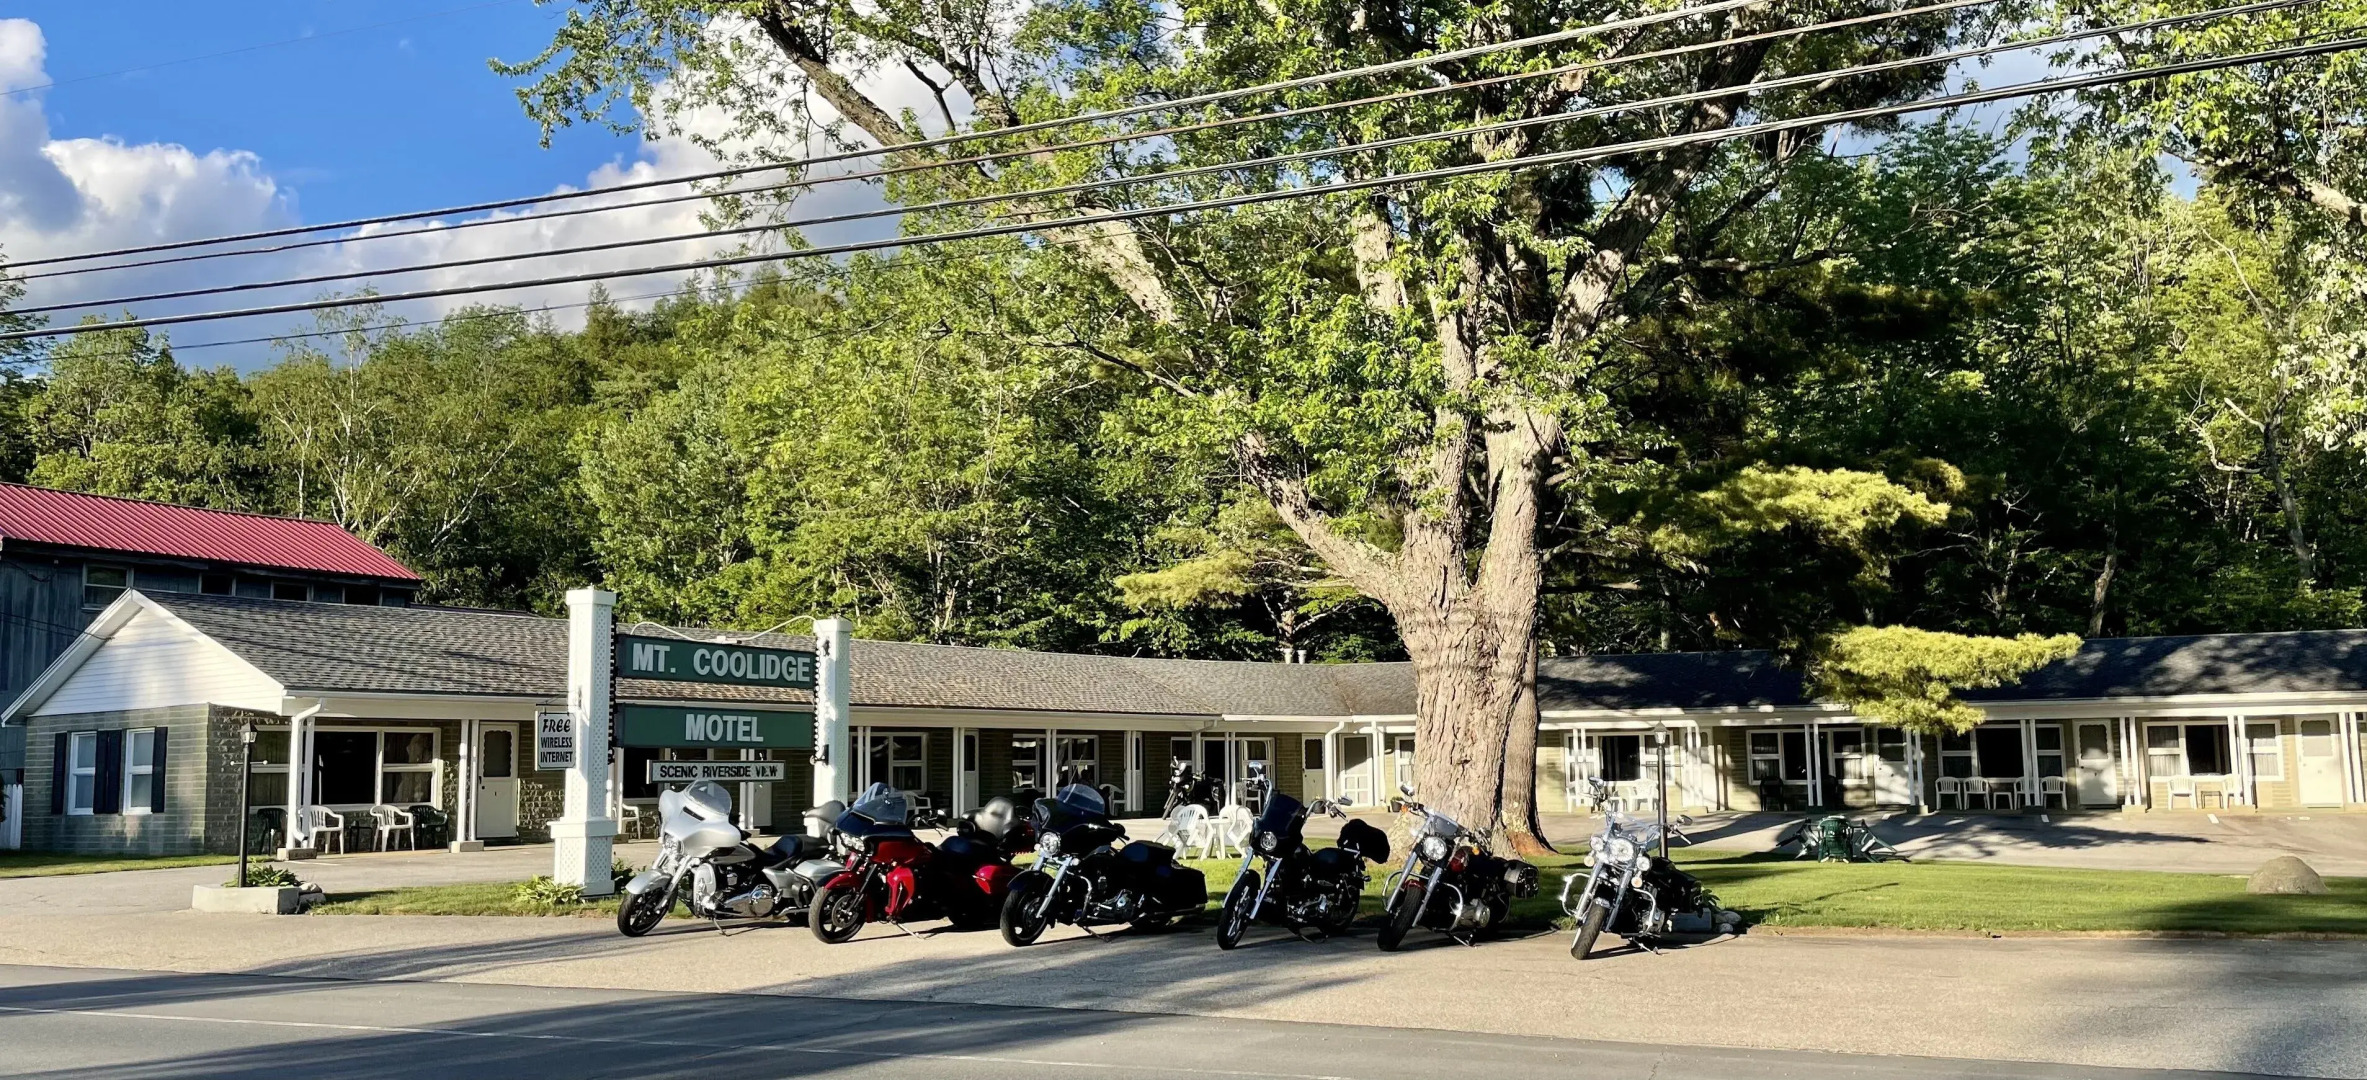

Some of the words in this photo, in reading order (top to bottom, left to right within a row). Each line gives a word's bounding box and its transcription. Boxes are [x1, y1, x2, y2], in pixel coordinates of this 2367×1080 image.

[633, 643, 676, 673] MT.
[693, 648, 811, 682] COOLIDGE
[542, 719, 571, 733] FREE
[686, 714, 764, 742] MOTEL
[541, 737, 572, 748] WIRELESS
[541, 751, 573, 763] INTERNET
[660, 765, 698, 778] SCENIC
[702, 766, 751, 778] RIVERSIDE
